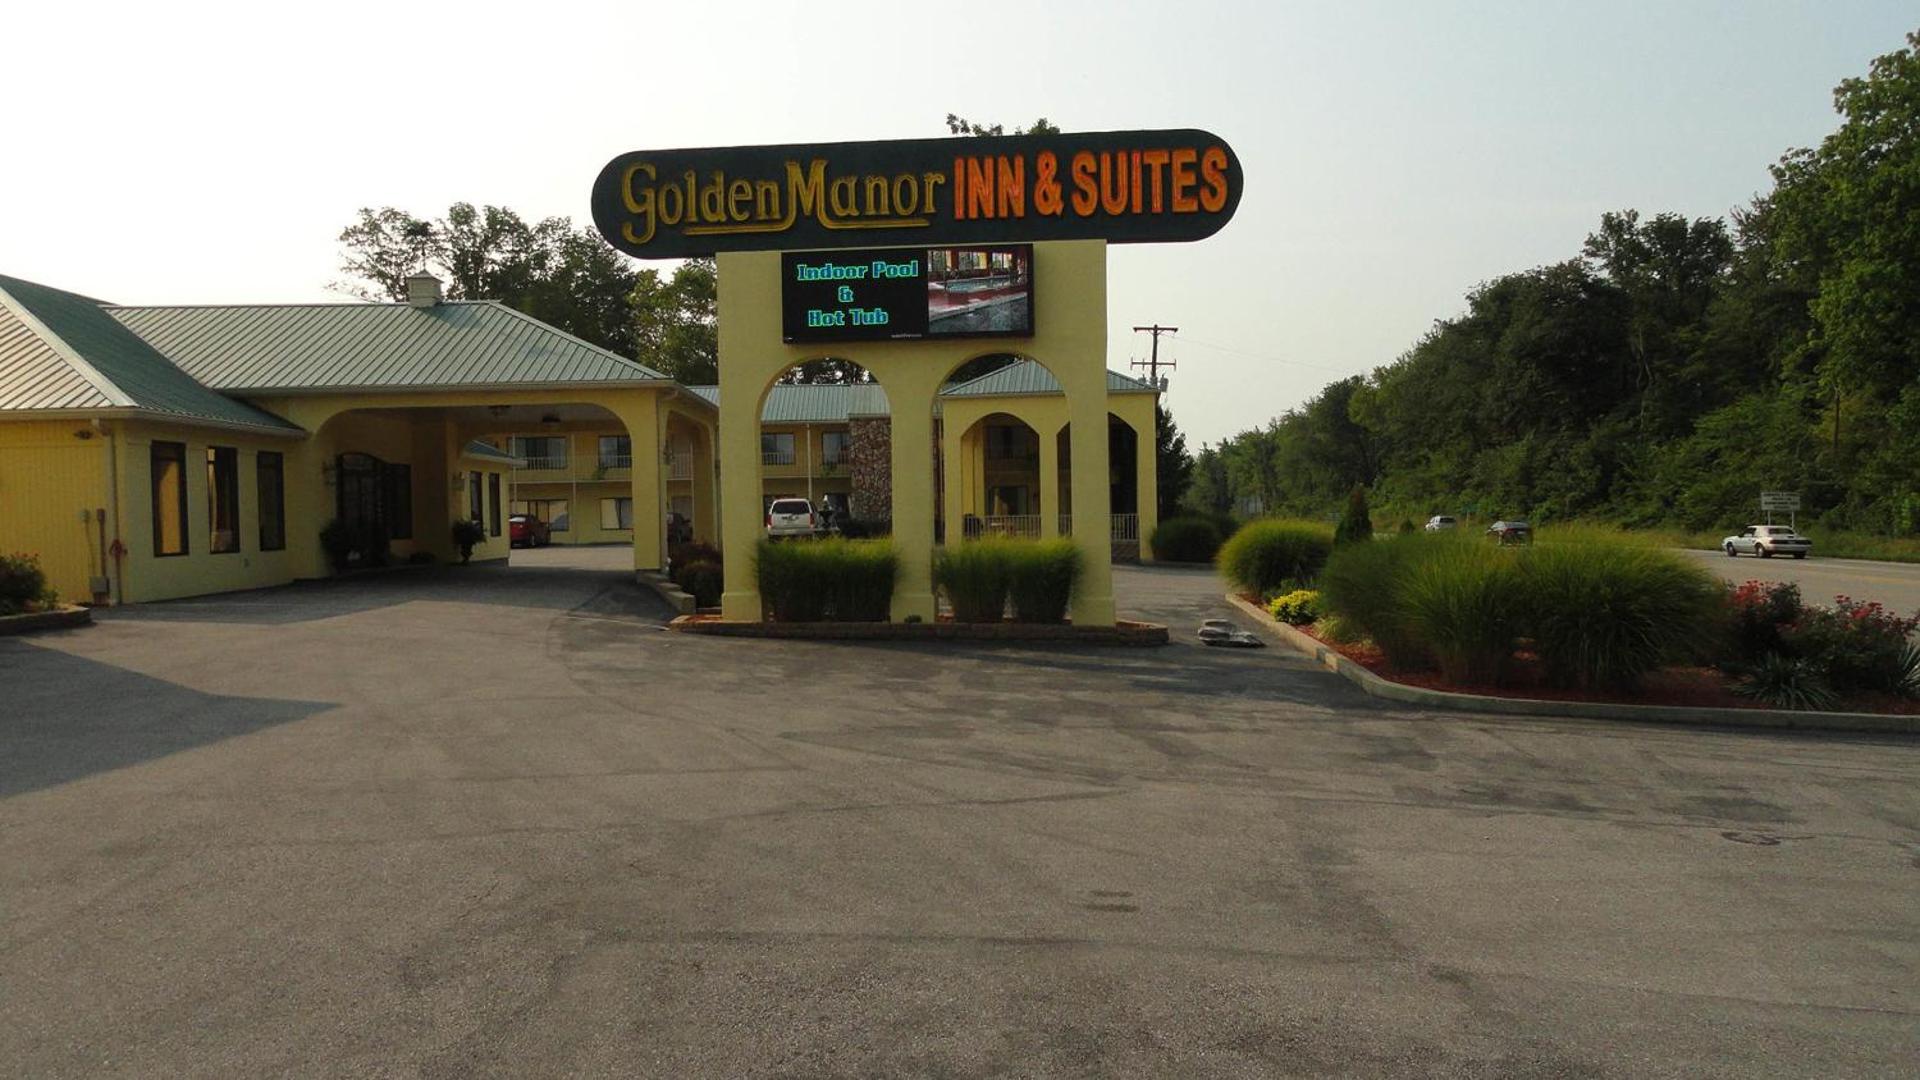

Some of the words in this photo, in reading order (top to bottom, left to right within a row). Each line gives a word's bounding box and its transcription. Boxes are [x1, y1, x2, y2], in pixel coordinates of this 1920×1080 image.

[621, 162, 782, 244] Golden
[785, 158, 946, 230] Manor
[954, 155, 1025, 220] INN
[1034, 151, 1064, 217] &
[1071, 147, 1229, 217] SUITES
[797, 264, 868, 281] Indoor
[872, 260, 919, 278] Pool
[838, 285, 854, 303] &
[808, 309, 846, 327] Hot
[849, 308, 889, 325] Tub
